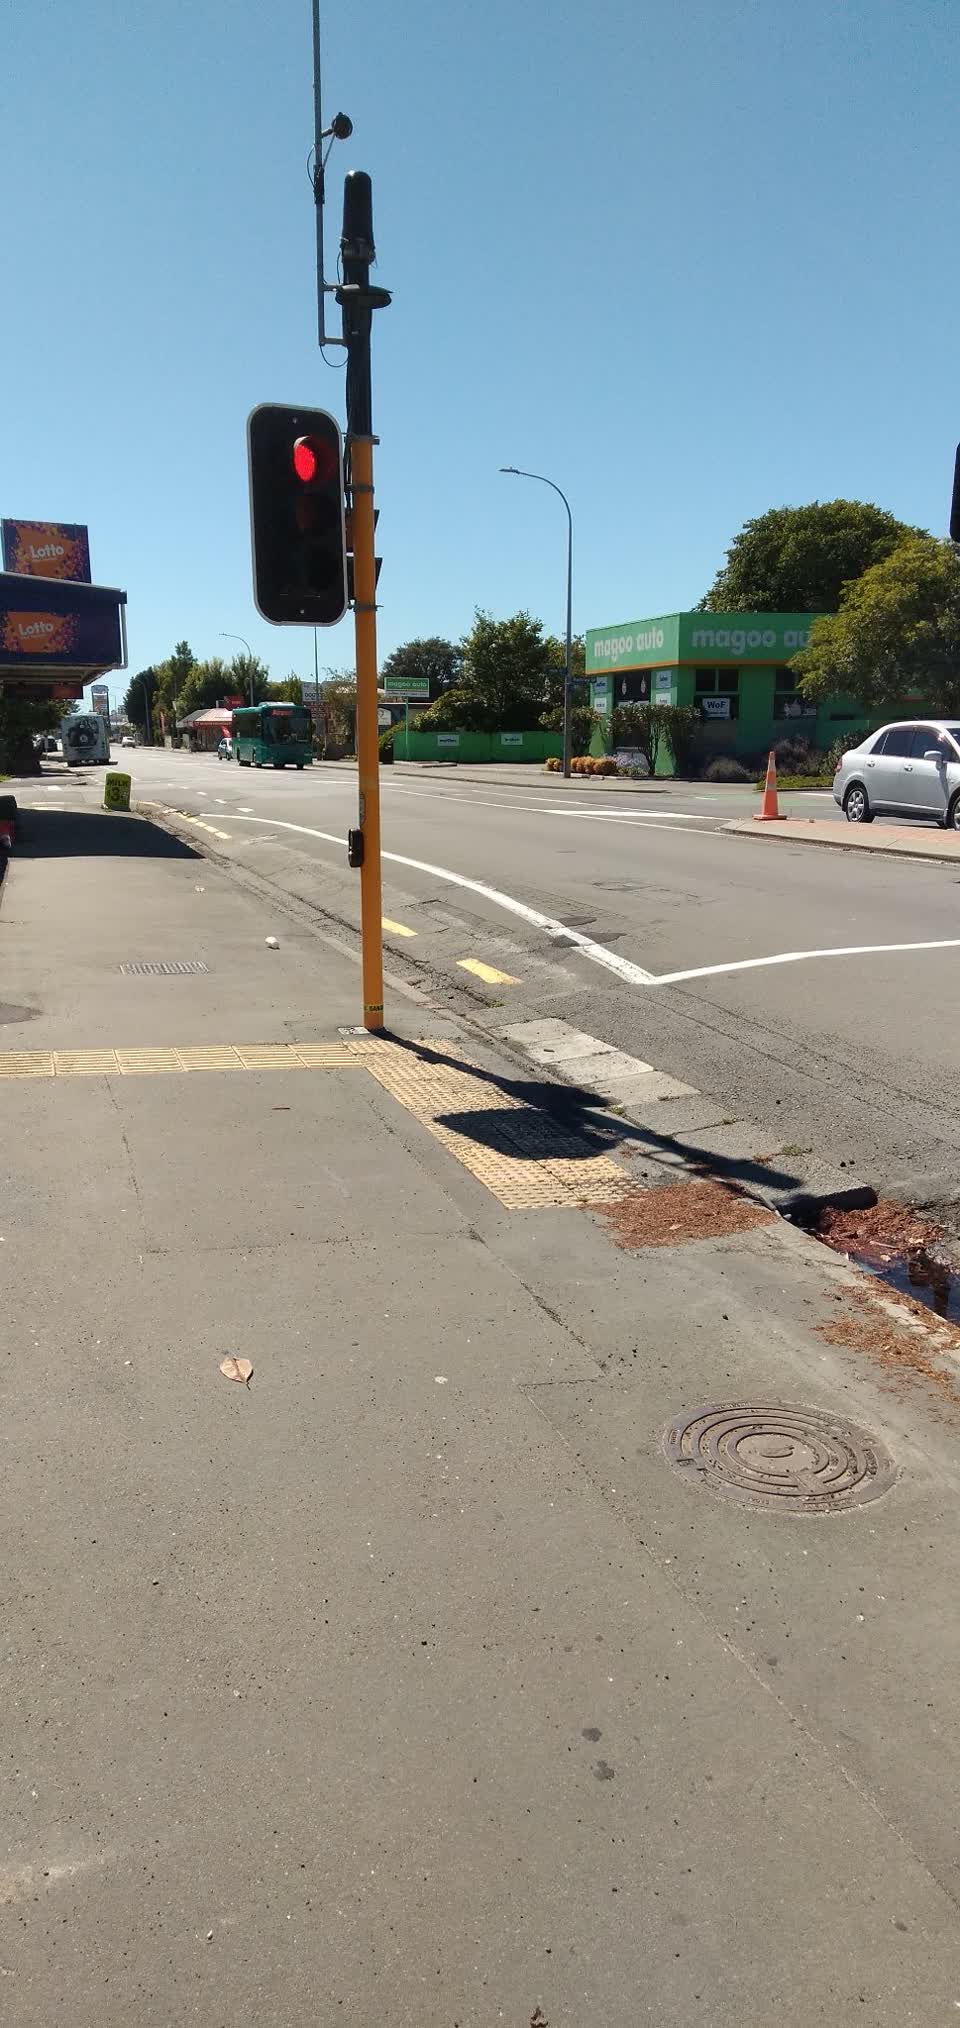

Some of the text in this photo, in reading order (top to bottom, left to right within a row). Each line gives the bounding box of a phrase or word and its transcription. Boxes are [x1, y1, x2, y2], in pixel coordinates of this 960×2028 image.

[29, 544, 64, 559] Lotto
[18, 622, 54, 636] Lotto
[594, 627, 664, 663] magoo auto
[690, 629, 809, 655] magoo au
[707, 700, 727, 709] WoF
[106, 779, 128, 787] MILK
